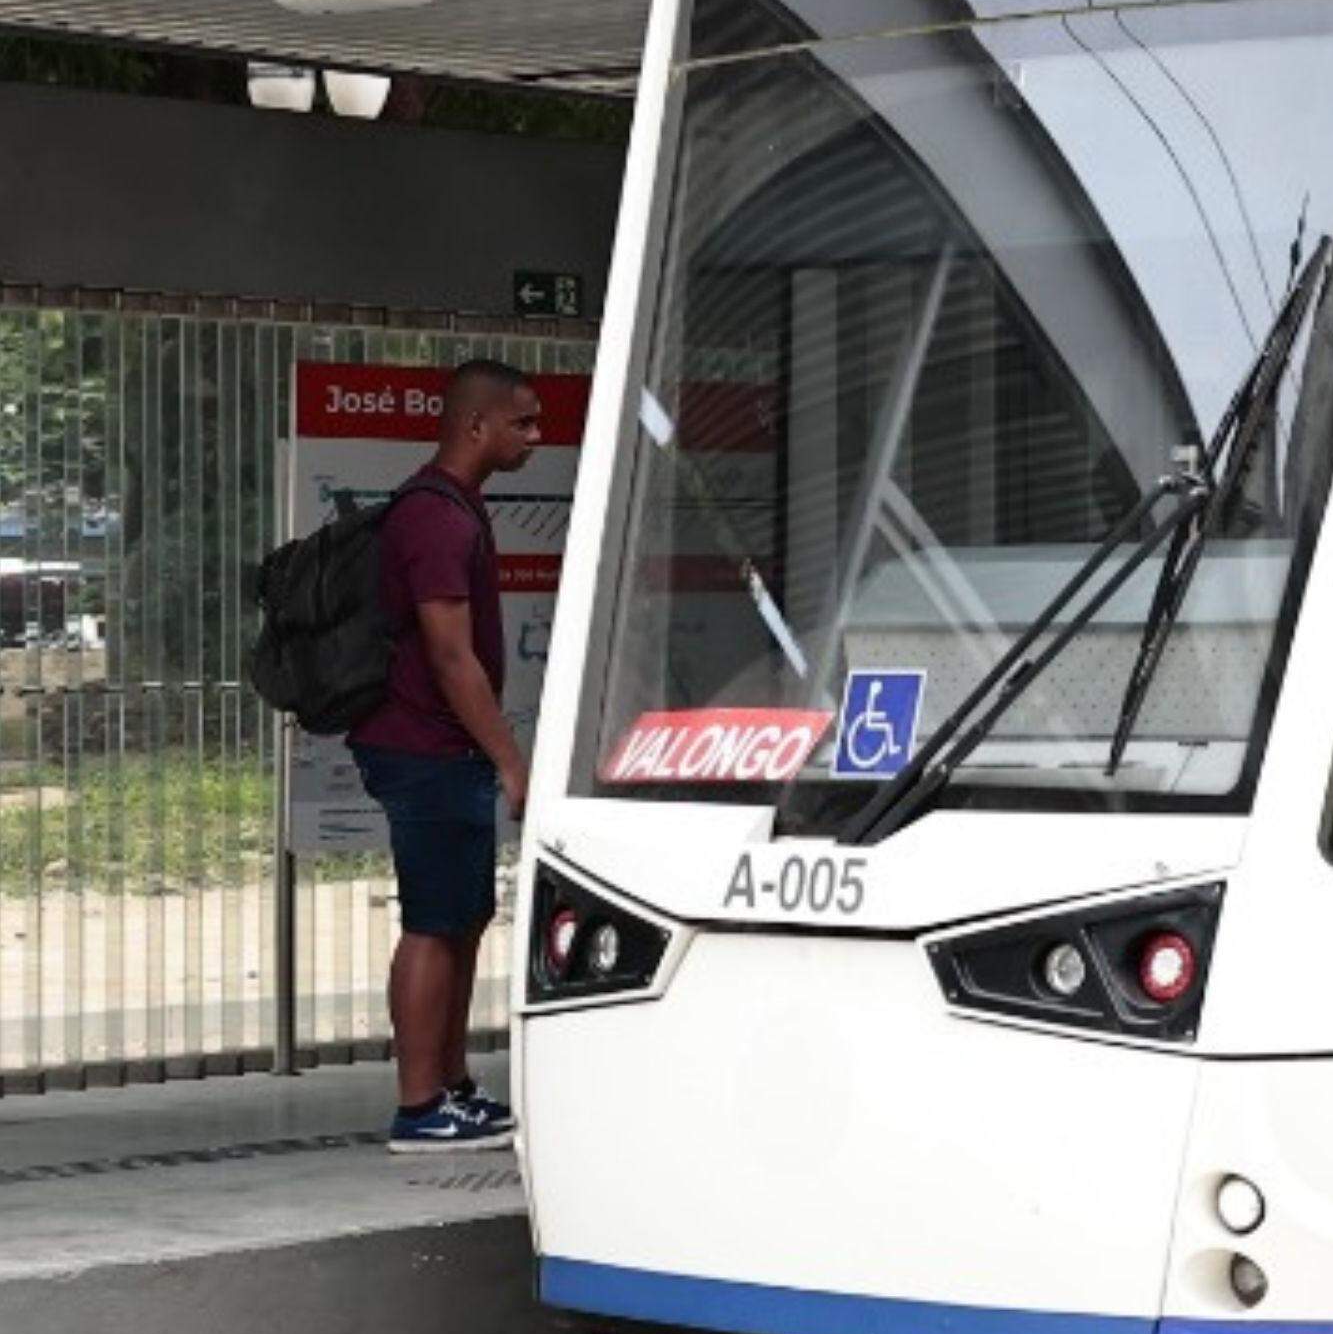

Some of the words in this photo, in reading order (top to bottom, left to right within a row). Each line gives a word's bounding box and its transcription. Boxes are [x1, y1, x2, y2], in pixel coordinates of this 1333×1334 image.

[325, 385, 395, 414] José
[404, 388, 445, 416] Bo
[611, 724, 813, 780] VALONGO
[723, 853, 868, 913] A-005
